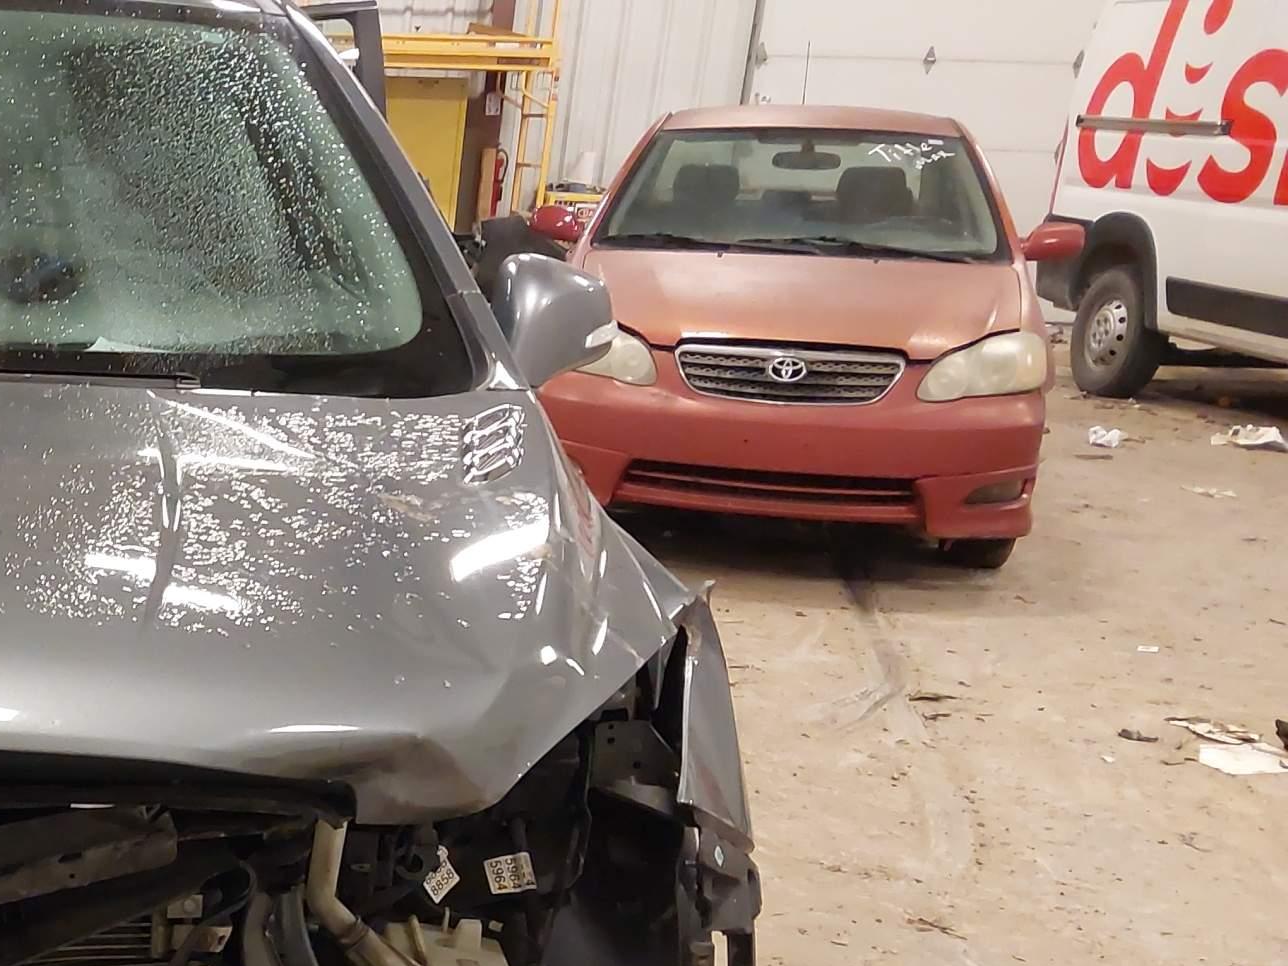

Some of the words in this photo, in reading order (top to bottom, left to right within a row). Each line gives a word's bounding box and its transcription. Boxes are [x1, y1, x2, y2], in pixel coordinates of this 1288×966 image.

[1077, 0, 1288, 205] dis
[430, 868, 455, 896] 8858
[490, 860, 508, 891] 5964
